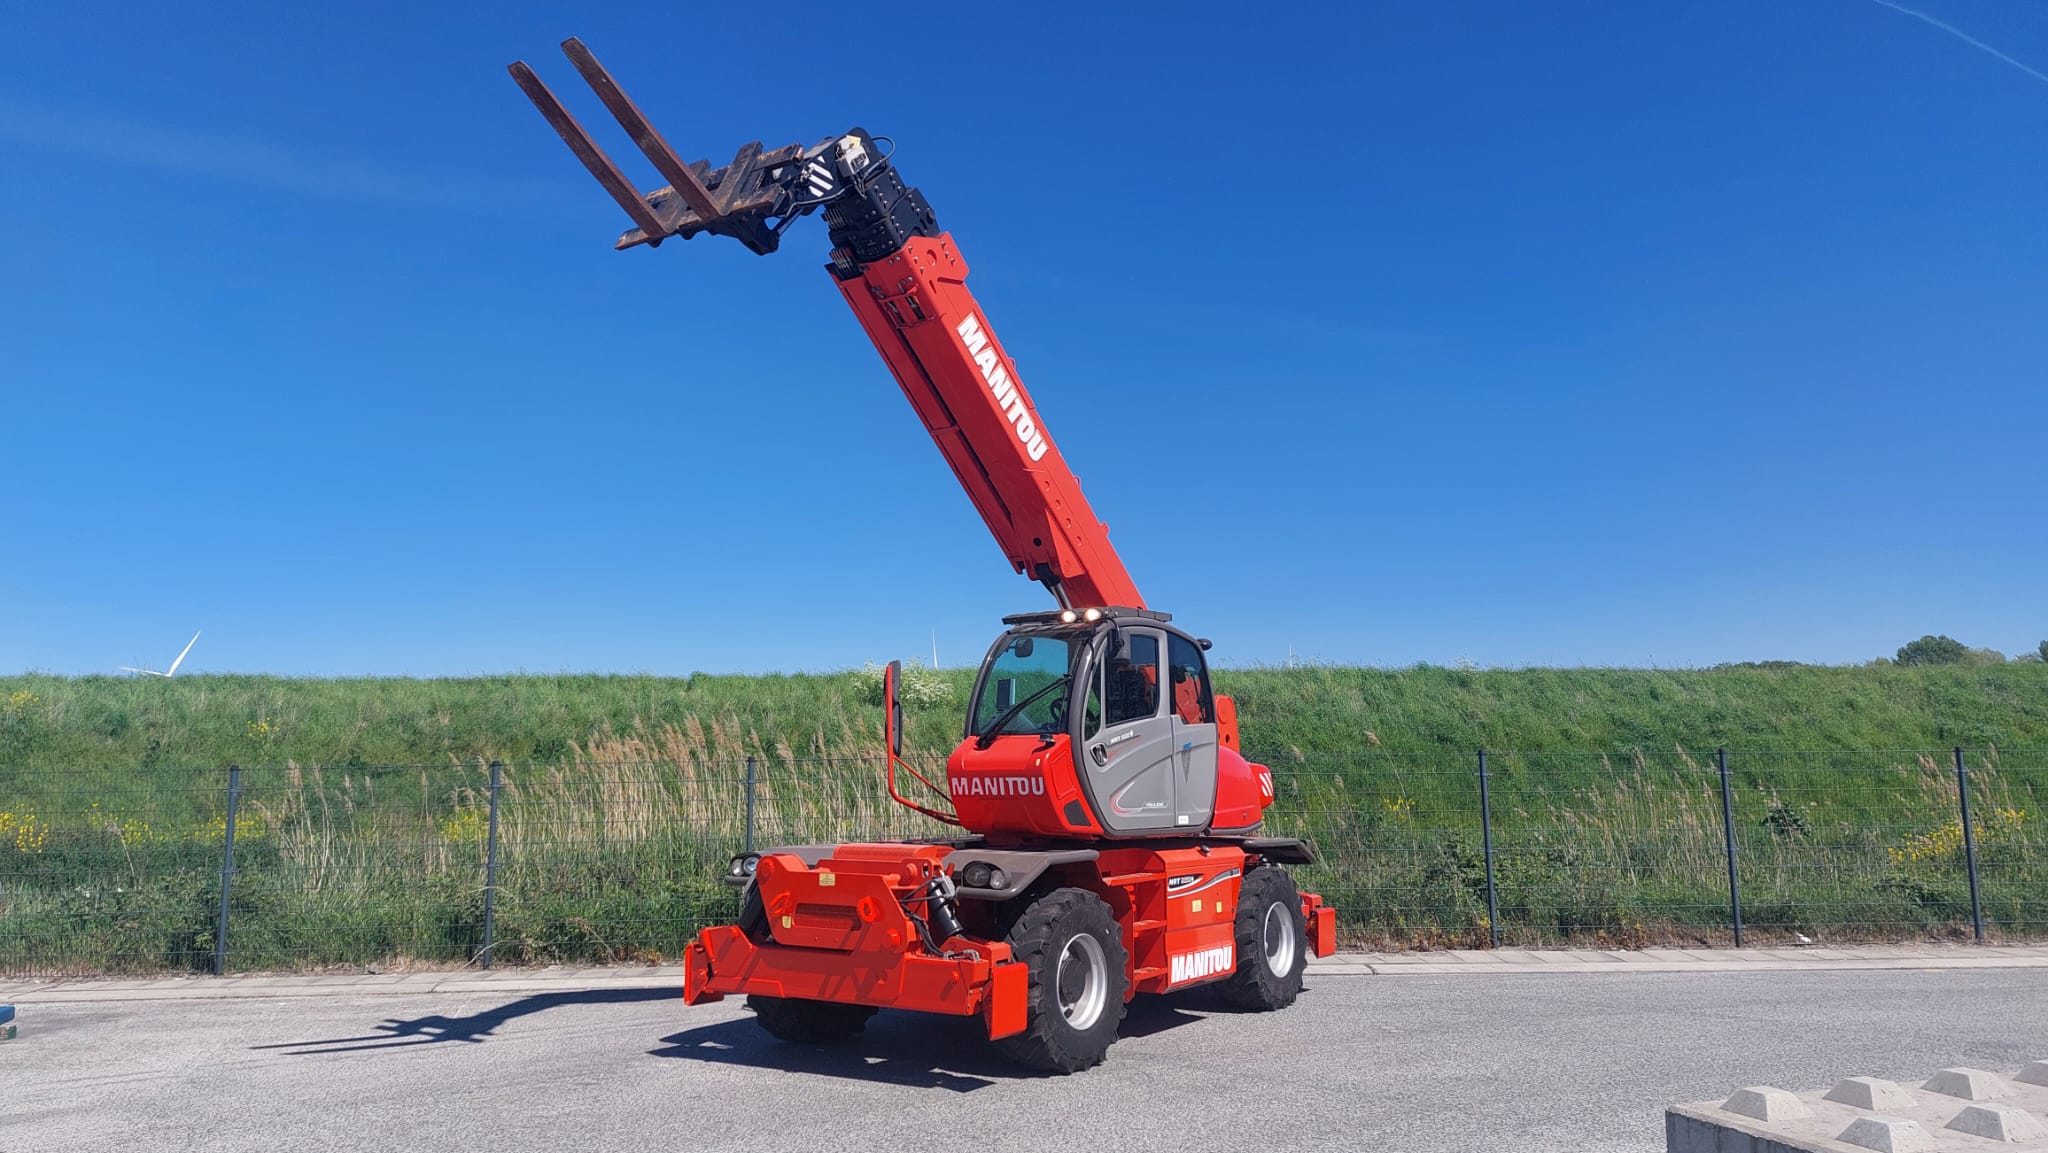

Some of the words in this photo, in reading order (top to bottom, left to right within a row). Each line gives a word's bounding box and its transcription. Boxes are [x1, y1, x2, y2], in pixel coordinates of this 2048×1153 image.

[957, 313, 1049, 461] MANITOU
[951, 776, 1045, 796] MANITOU
[1171, 945, 1233, 984] MANITOU
